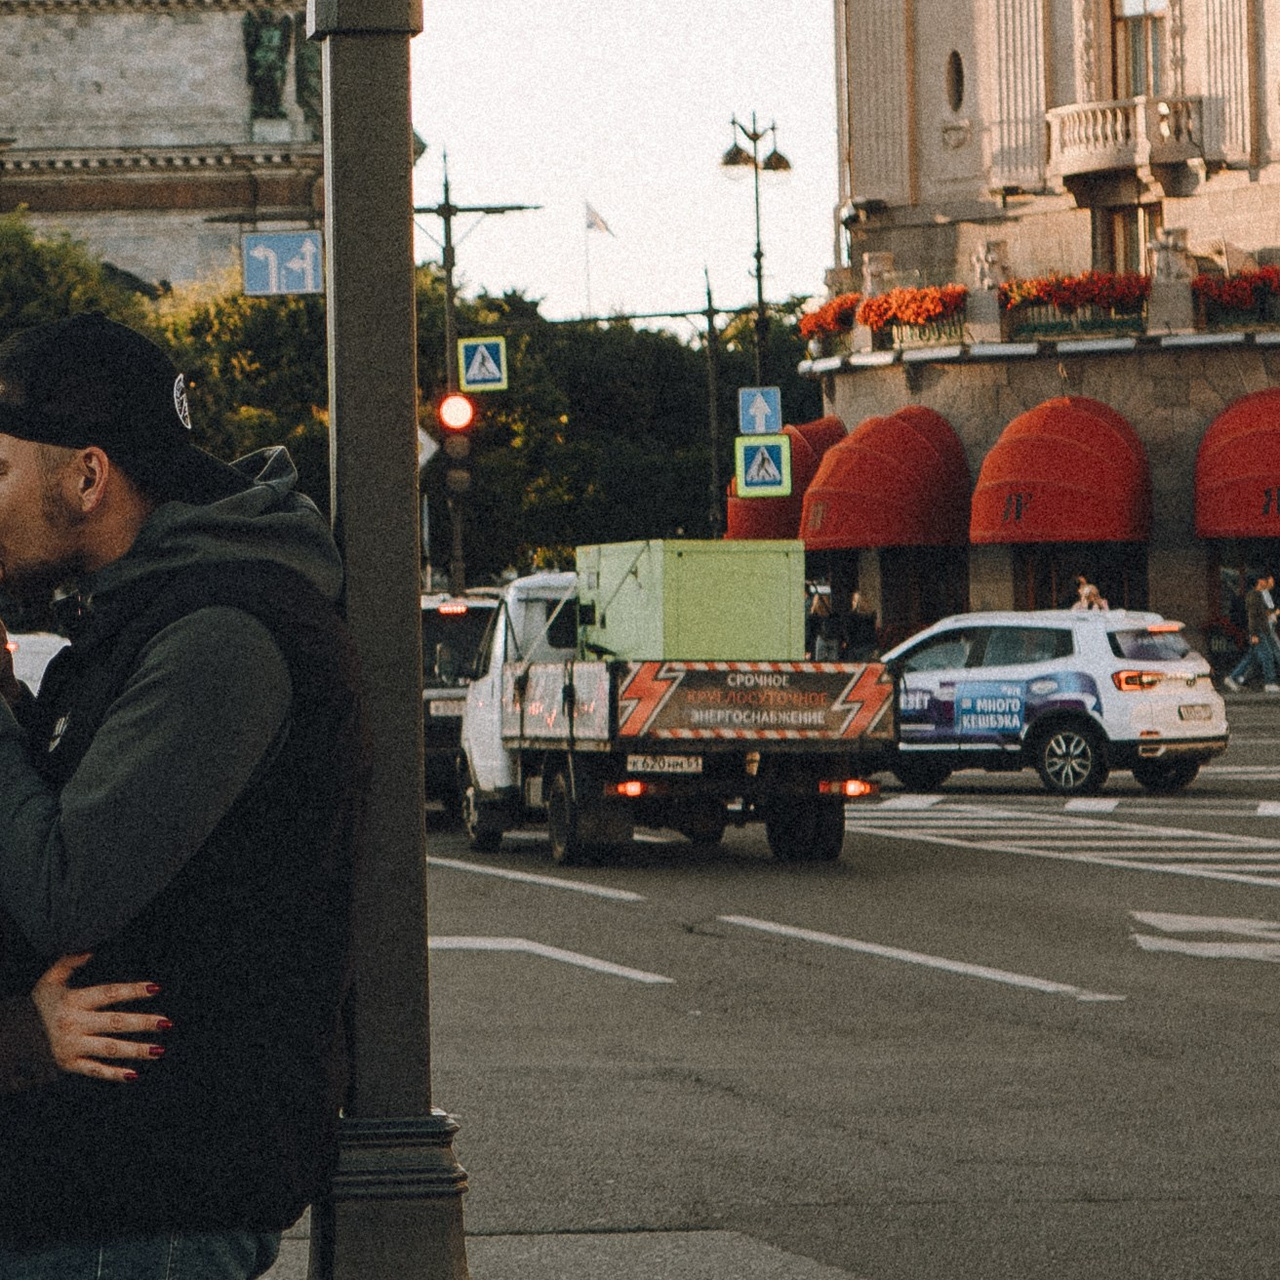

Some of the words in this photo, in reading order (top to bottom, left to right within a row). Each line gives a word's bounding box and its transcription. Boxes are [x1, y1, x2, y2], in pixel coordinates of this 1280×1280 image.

[726, 673, 790, 688] СРОЧНОЕ
[976, 698, 1021, 713] МНОГО
[689, 707, 826, 725] ЭНЕРГОСНАБЖЕНИЕ
[962, 714, 1021, 729] КЕШБЭКА
